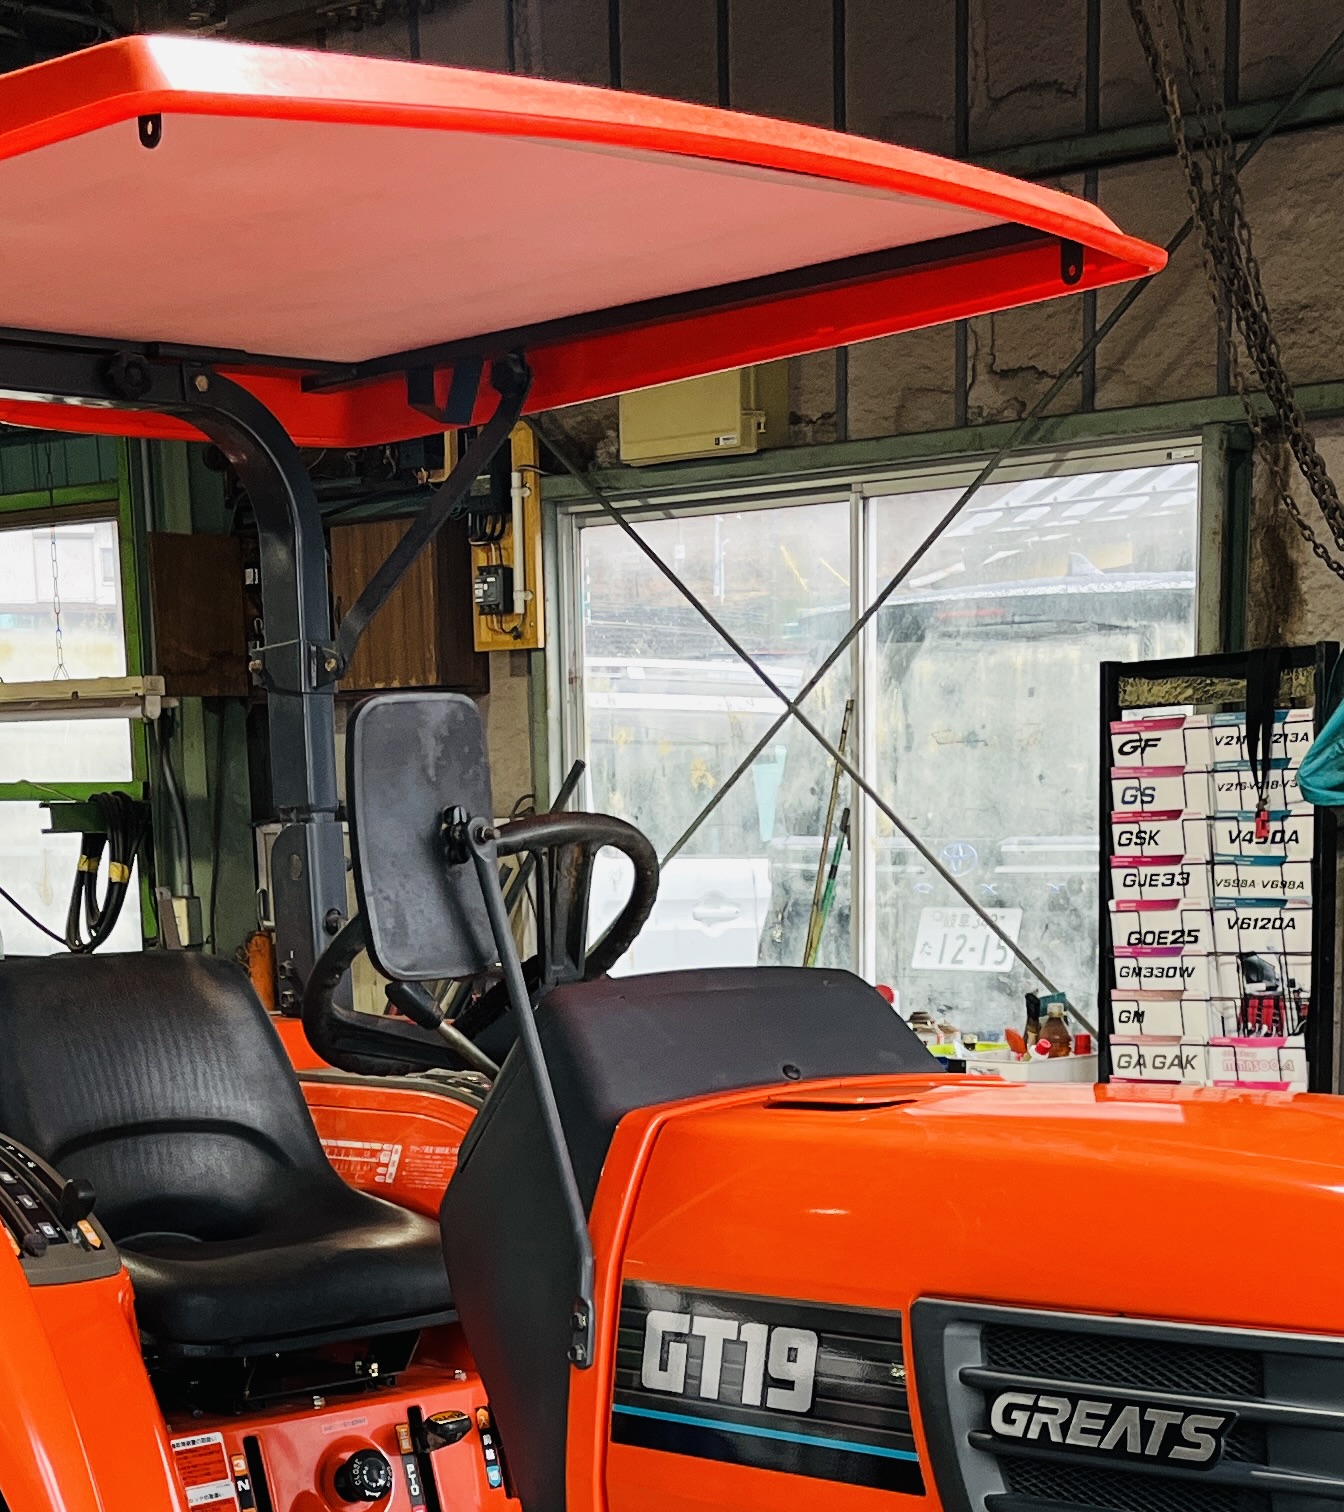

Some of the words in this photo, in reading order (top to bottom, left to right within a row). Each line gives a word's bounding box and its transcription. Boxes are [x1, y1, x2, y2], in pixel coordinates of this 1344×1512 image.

[1117, 737, 1162, 756] GF
[1120, 786, 1157, 805] GS
[1117, 829, 1162, 848] GSK
[640, 1309, 819, 1414] GT19
[989, 1390, 1226, 1463] GREATS
[236, 1478, 251, 1493] N
